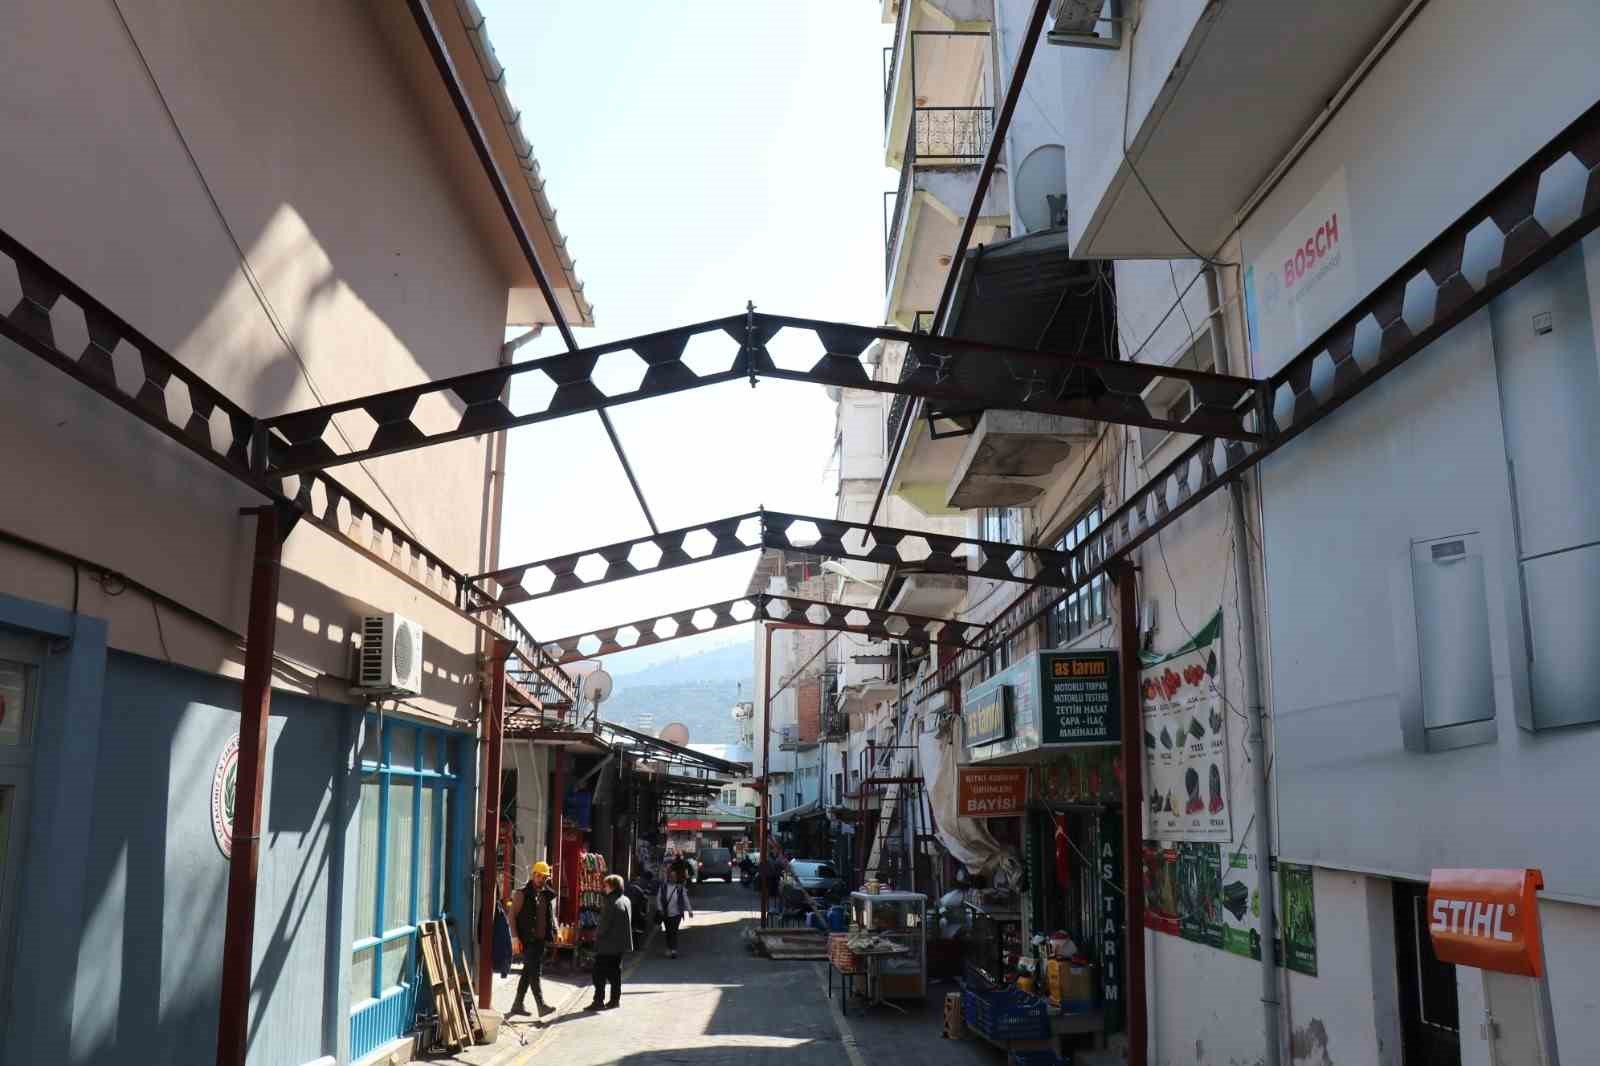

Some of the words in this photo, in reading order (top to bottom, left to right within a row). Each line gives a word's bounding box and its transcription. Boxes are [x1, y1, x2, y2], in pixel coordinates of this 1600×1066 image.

[1285, 212, 1339, 288] BOSCH
[1055, 662, 1069, 675] as
[1084, 705, 1107, 714] HASAT
[1060, 716, 1080, 726] ÇAPA
[1431, 899, 1513, 942] STIHL
